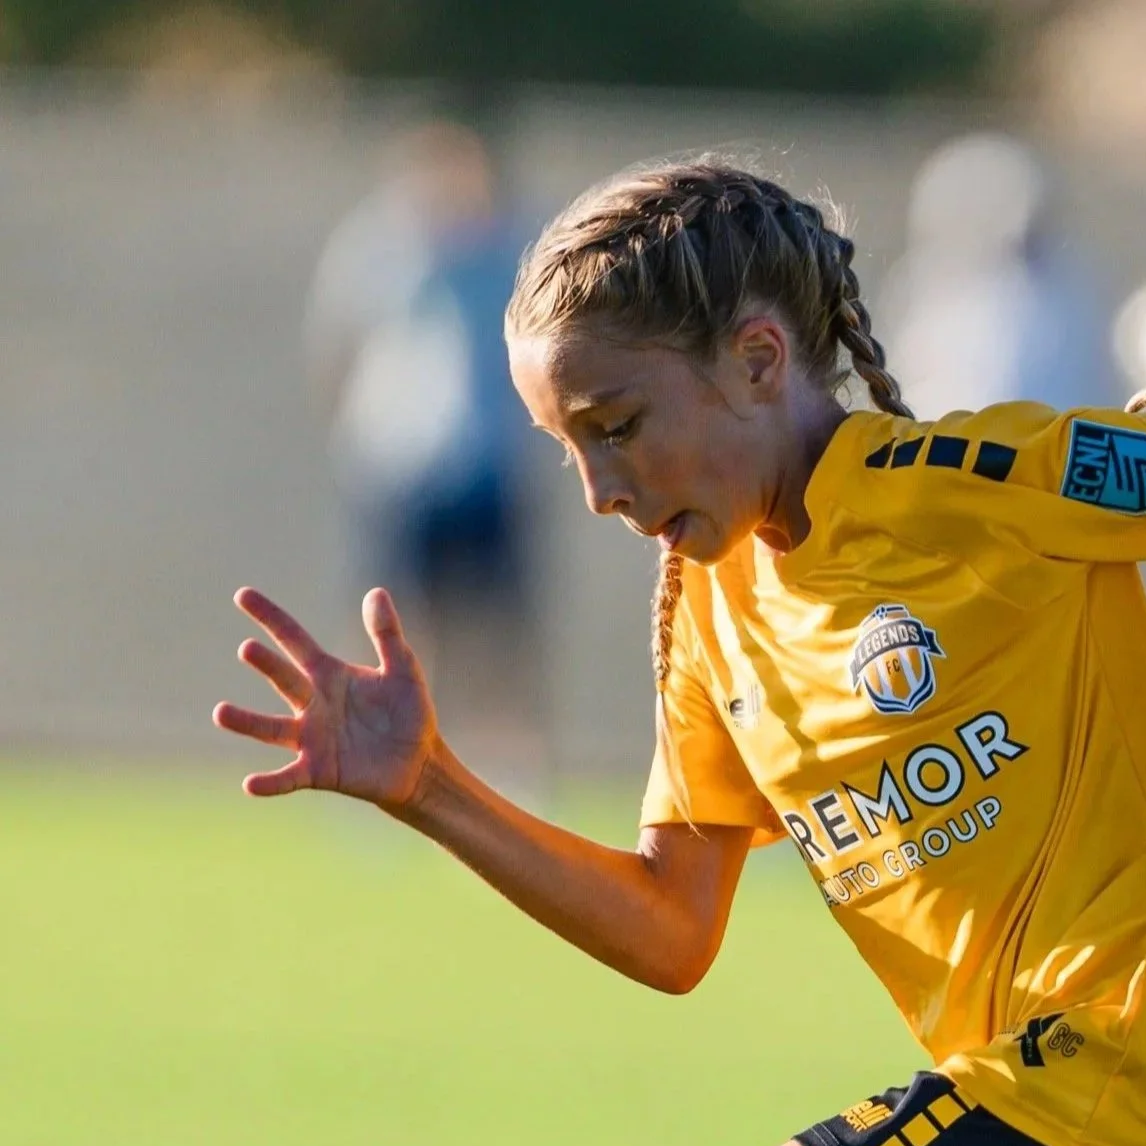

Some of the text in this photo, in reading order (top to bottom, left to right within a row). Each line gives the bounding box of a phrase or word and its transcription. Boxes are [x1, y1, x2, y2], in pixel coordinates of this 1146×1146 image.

[1067, 432, 1110, 501] ECNL
[857, 624, 920, 664] LEGENDS
[886, 658, 901, 675] FC
[779, 710, 1031, 862] REMOR
[882, 795, 1003, 878] GROUP
